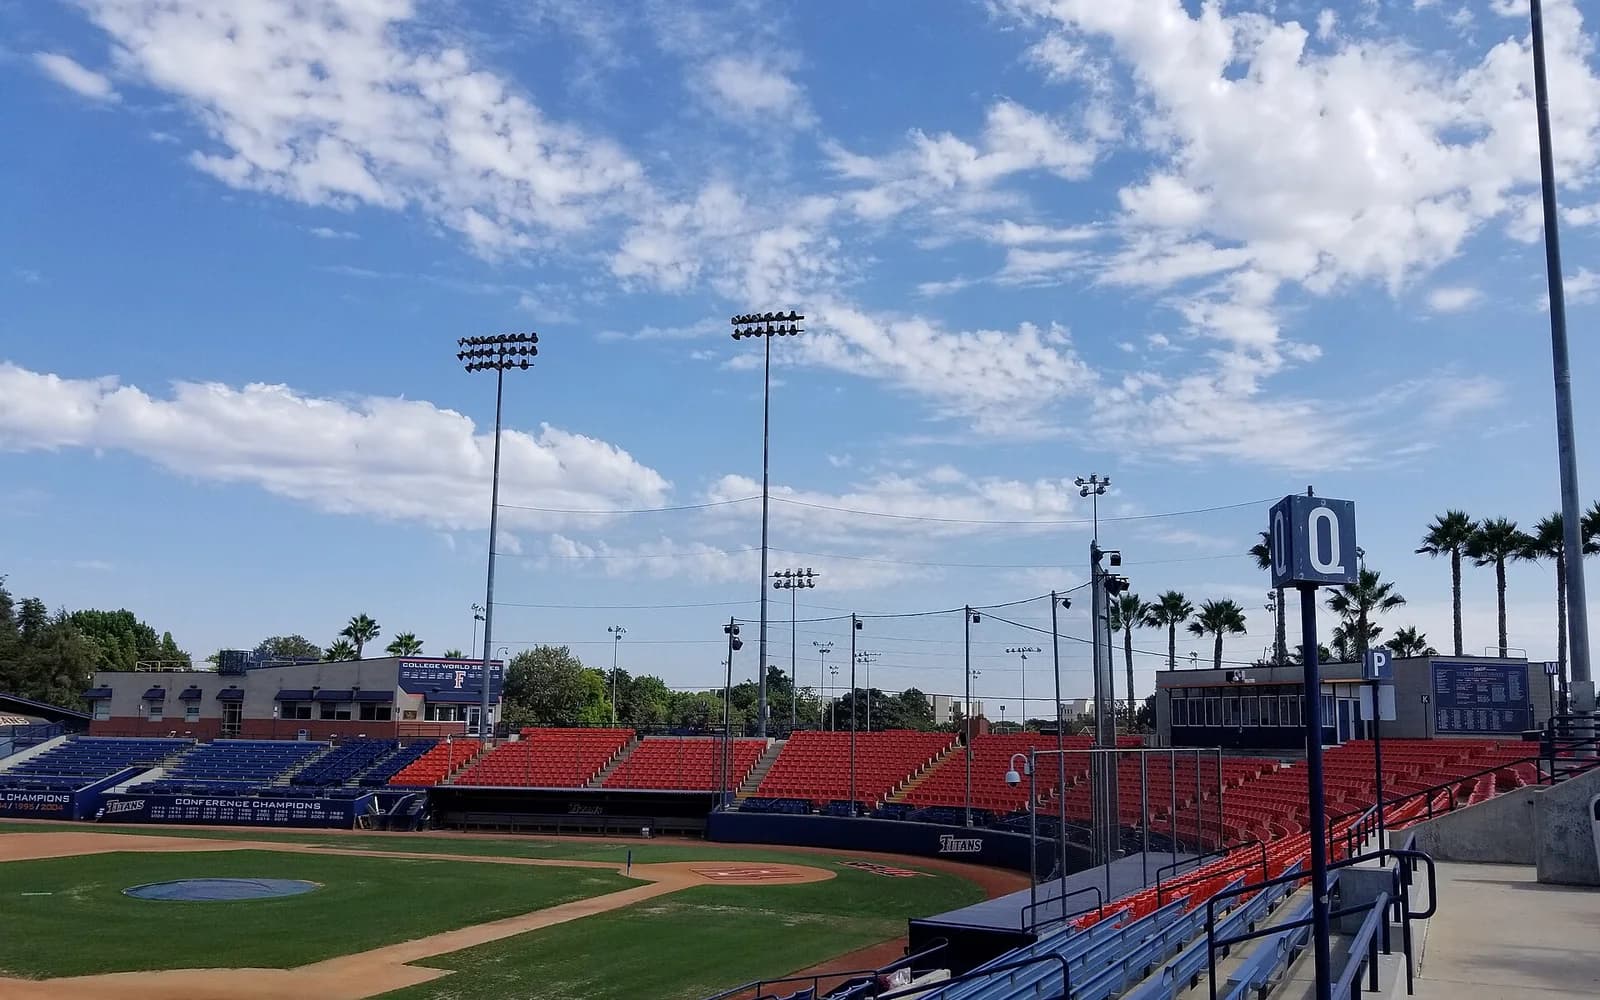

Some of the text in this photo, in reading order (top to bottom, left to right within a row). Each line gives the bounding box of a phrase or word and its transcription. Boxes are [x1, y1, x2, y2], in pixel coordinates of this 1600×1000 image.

[1274, 510, 1287, 577] Q
[1308, 506, 1345, 575] Q
[1373, 652, 1386, 677] P
[1545, 662, 1558, 674] M
[453, 670, 467, 689] F
[1421, 695, 1429, 703] K
[6, 793, 70, 803] CHAMPIONS
[106, 799, 146, 814] TITANS
[175, 798, 250, 808] CONFERENCE
[252, 801, 321, 810] CHAMPIONS
[938, 834, 984, 853] TITANS
